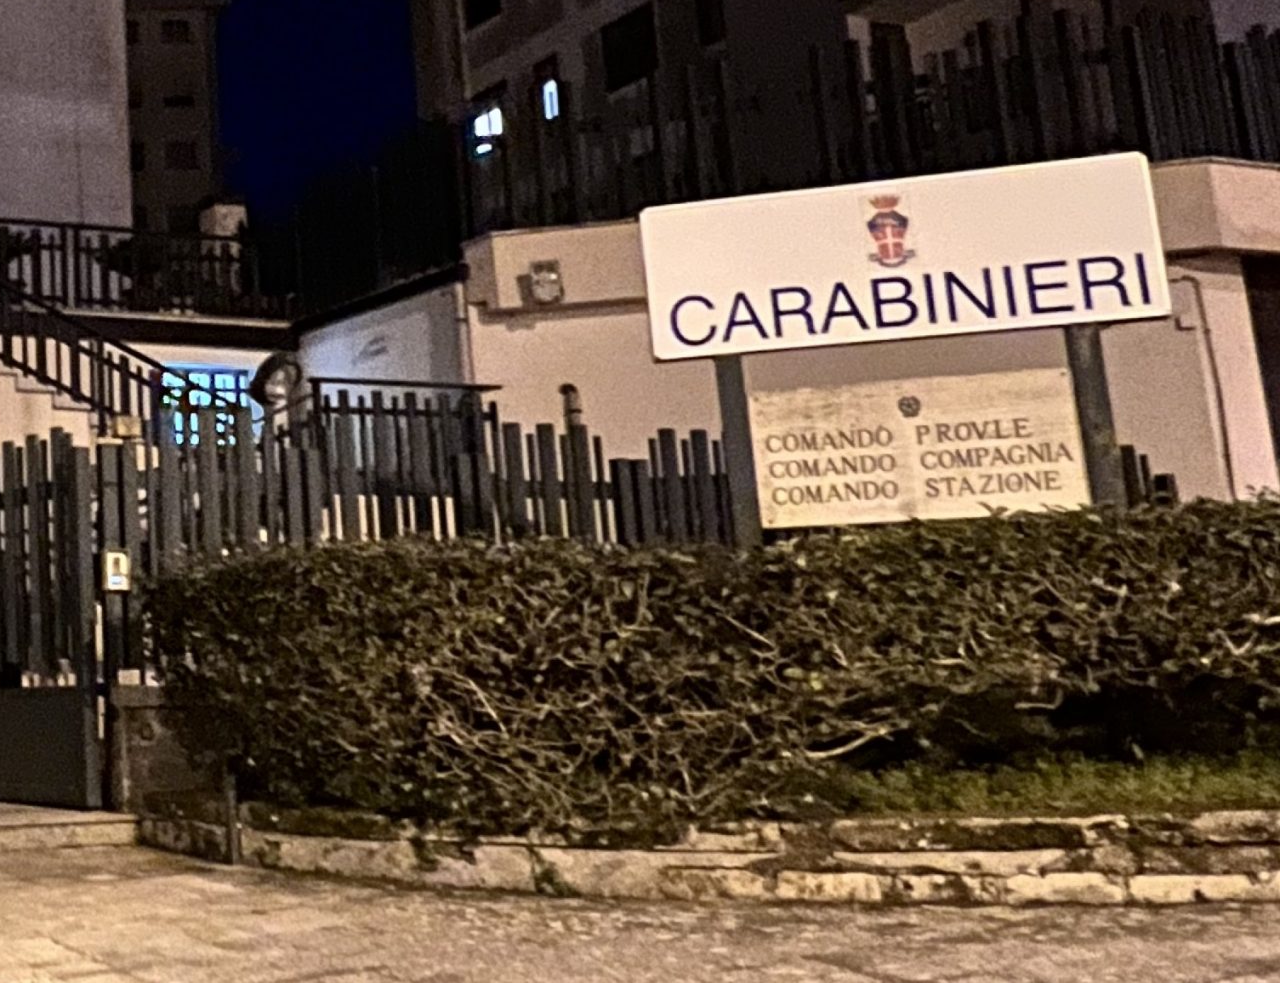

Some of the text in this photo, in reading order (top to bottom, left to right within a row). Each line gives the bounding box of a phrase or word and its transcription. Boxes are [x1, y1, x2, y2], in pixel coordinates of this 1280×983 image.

[670, 253, 1152, 346] CARABINIERI
[765, 428, 893, 454] COMANDO
[768, 442, 1074, 479] COMANDO COMPAGNIA
[772, 470, 1062, 506] COMANDO STAZIONE
